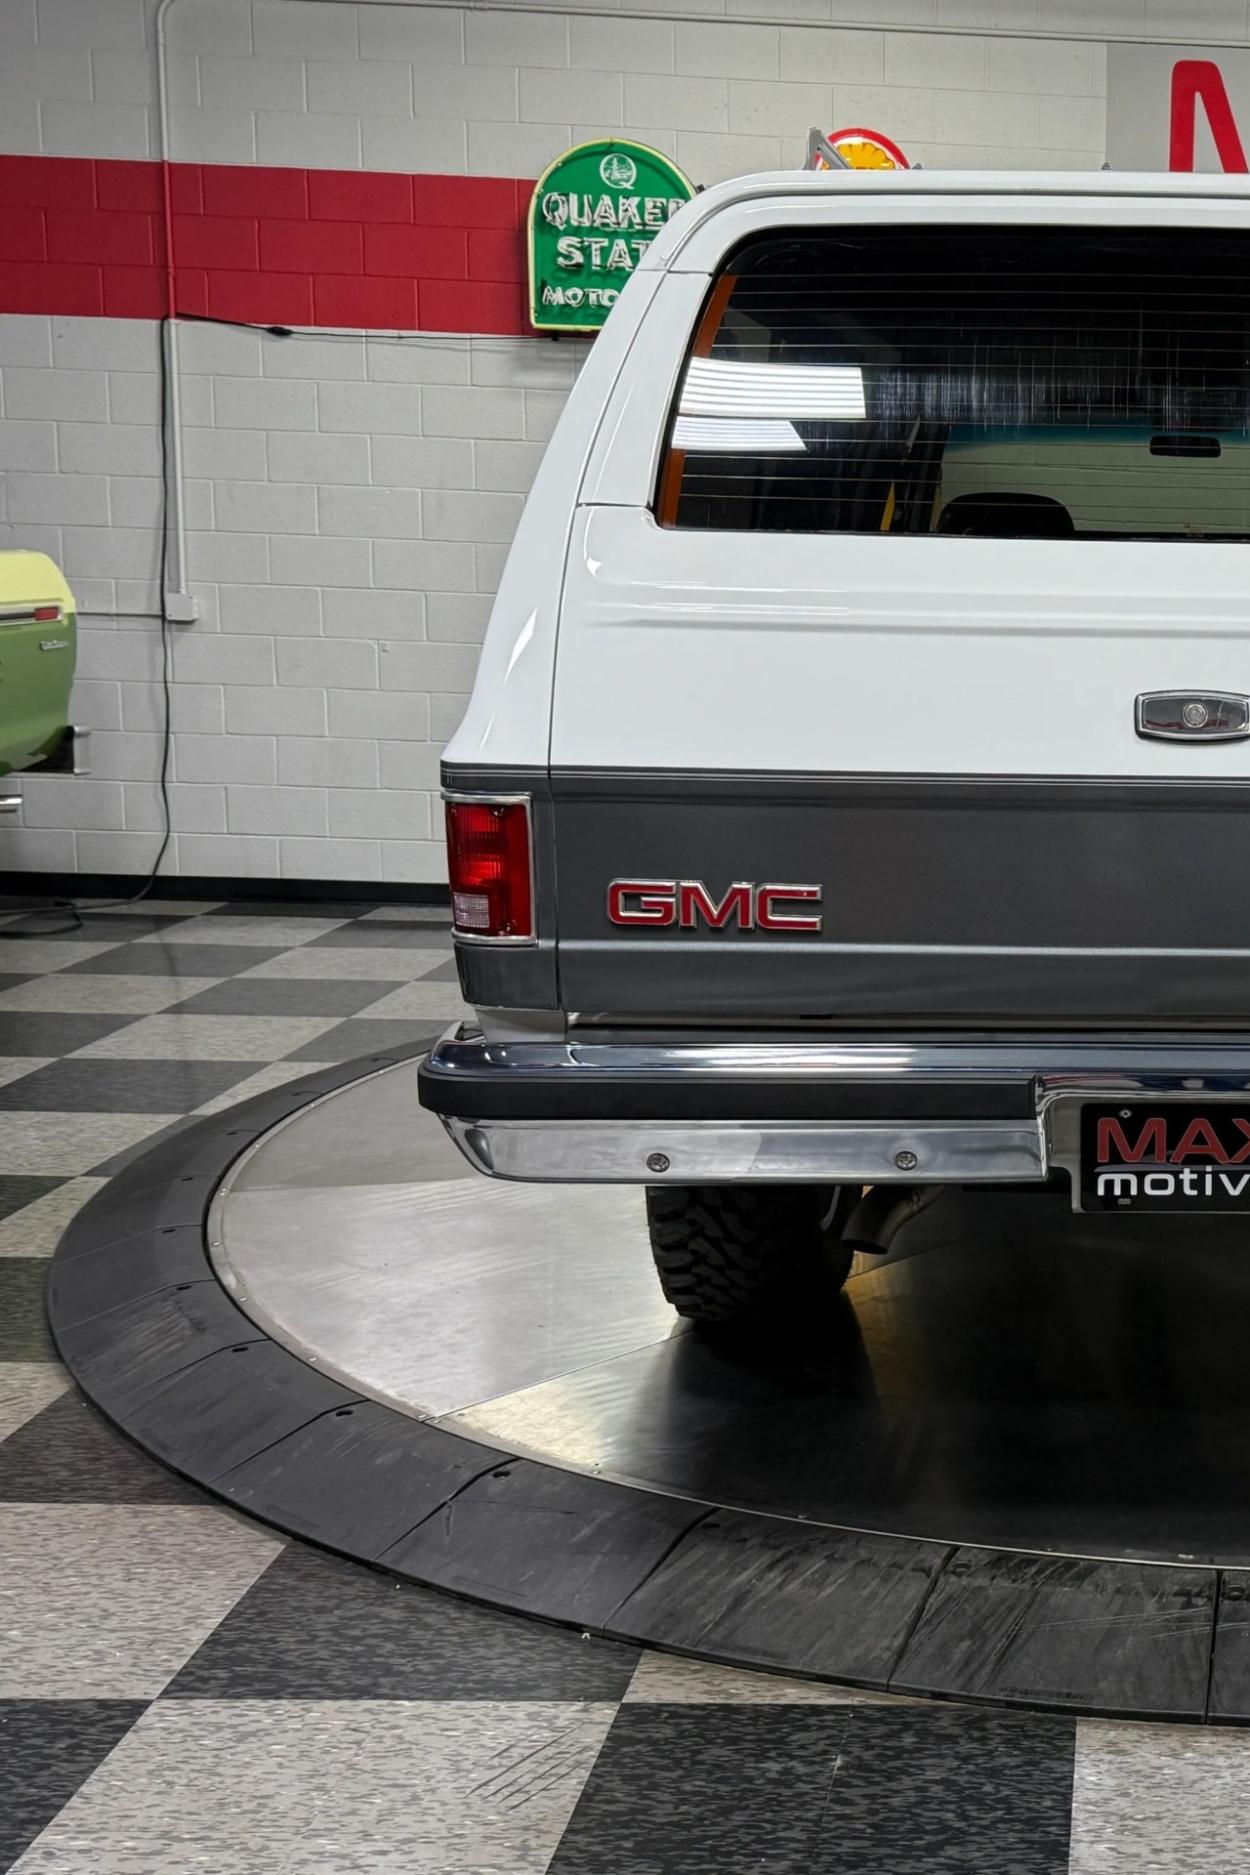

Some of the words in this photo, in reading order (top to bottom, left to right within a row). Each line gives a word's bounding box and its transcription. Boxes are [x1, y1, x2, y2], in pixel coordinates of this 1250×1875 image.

[556, 236, 652, 271] STAT
[542, 286, 620, 307] MOTO
[608, 878, 823, 931] GMC
